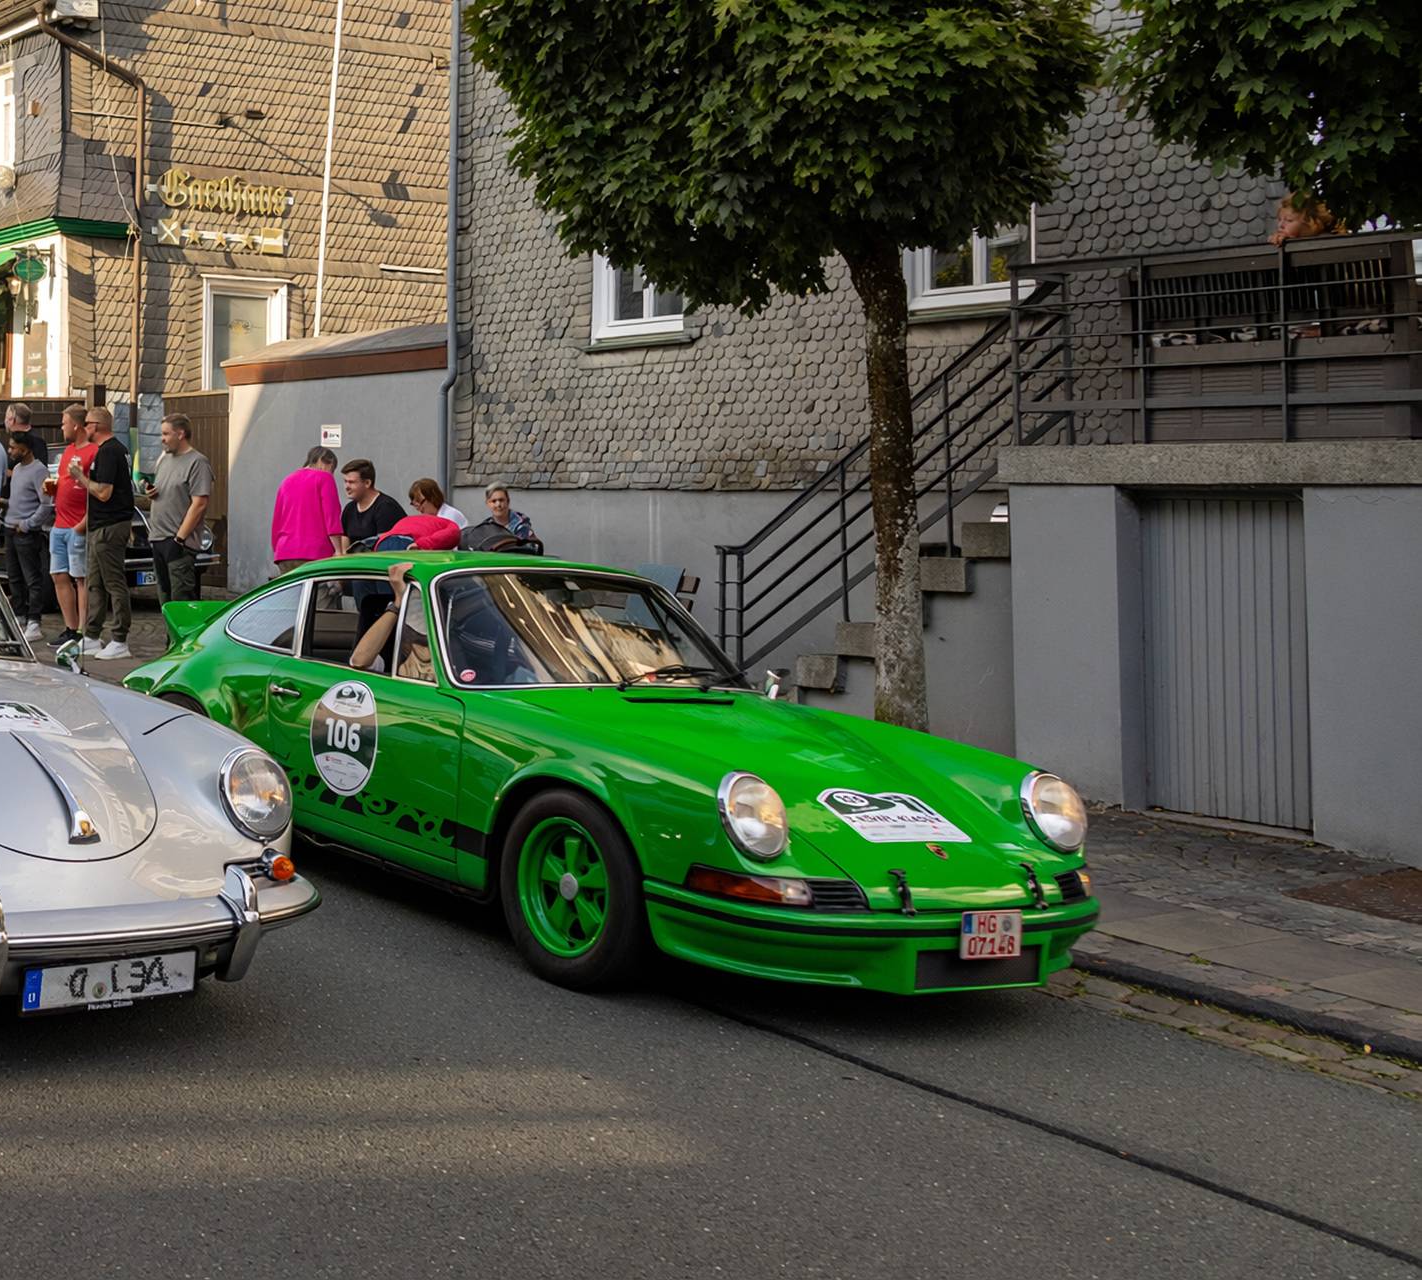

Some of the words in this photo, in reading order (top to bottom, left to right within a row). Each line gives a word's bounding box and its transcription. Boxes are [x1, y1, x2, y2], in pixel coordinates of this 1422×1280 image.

[157, 167, 287, 217] Gasthaus
[325, 717, 361, 753] 106
[977, 915, 997, 934] HG
